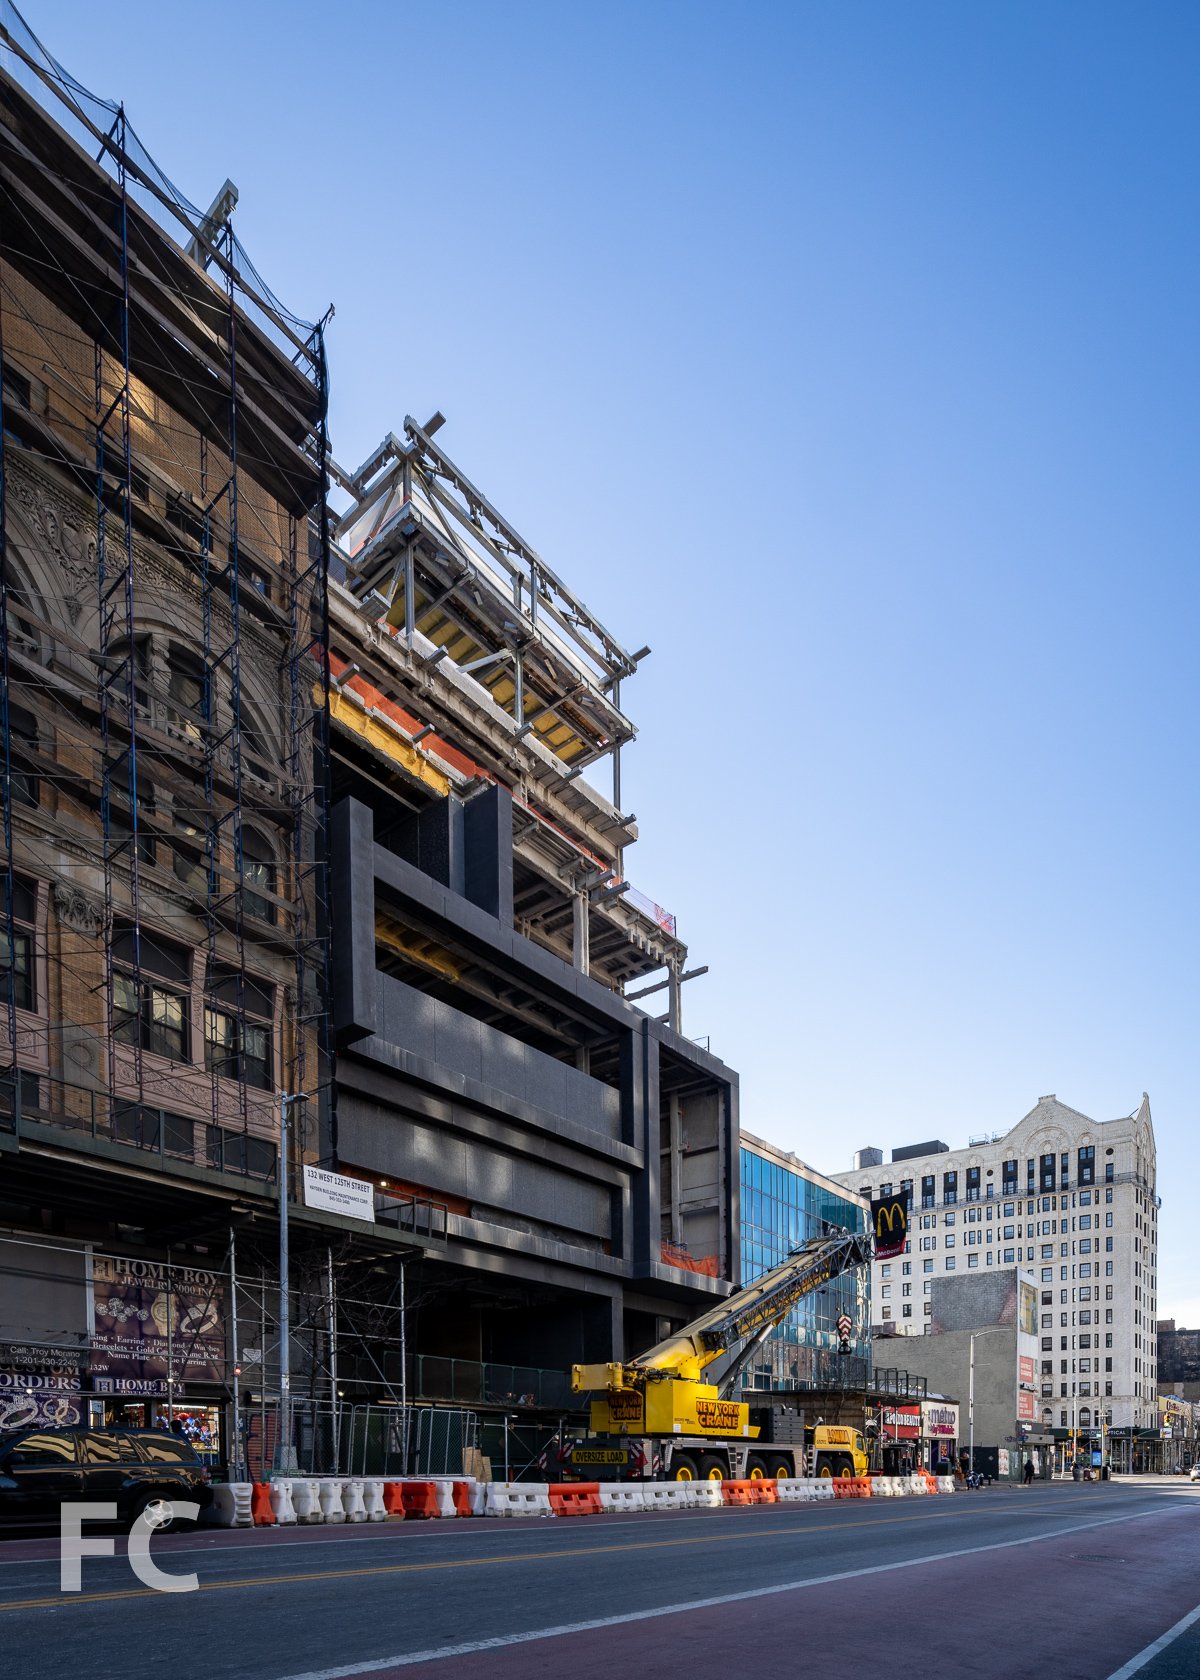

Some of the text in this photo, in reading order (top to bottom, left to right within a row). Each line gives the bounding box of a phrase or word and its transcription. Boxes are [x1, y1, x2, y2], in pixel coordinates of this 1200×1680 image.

[308, 1170, 370, 1193] 132 WEST 125TH STREET
[323, 1188, 337, 1196] BUILDING
[338, 1193, 359, 1202] MAINTENANCE
[115, 1258, 218, 1287] HOME BOY
[93, 1341, 128, 1351] Bracelets
[136, 1345, 155, 1354] Gold
[117, 1336, 145, 1346] Earring
[31, 1347, 49, 1356] Troy
[51, 1349, 80, 1357] Morano
[107, 1351, 130, 1360] Name
[131, 1353, 150, 1361] Plate
[0, 1373, 82, 1390] ORDERS
[115, 1379, 157, 1391] HOME
[611, 1407, 641, 1420] CRANE
[696, 1401, 740, 1416] NEW YORK
[698, 1415, 739, 1429] CRANE
[931, 1407, 956, 1425] metro
[575, 1452, 623, 1462] OVERSIZE LOAD
